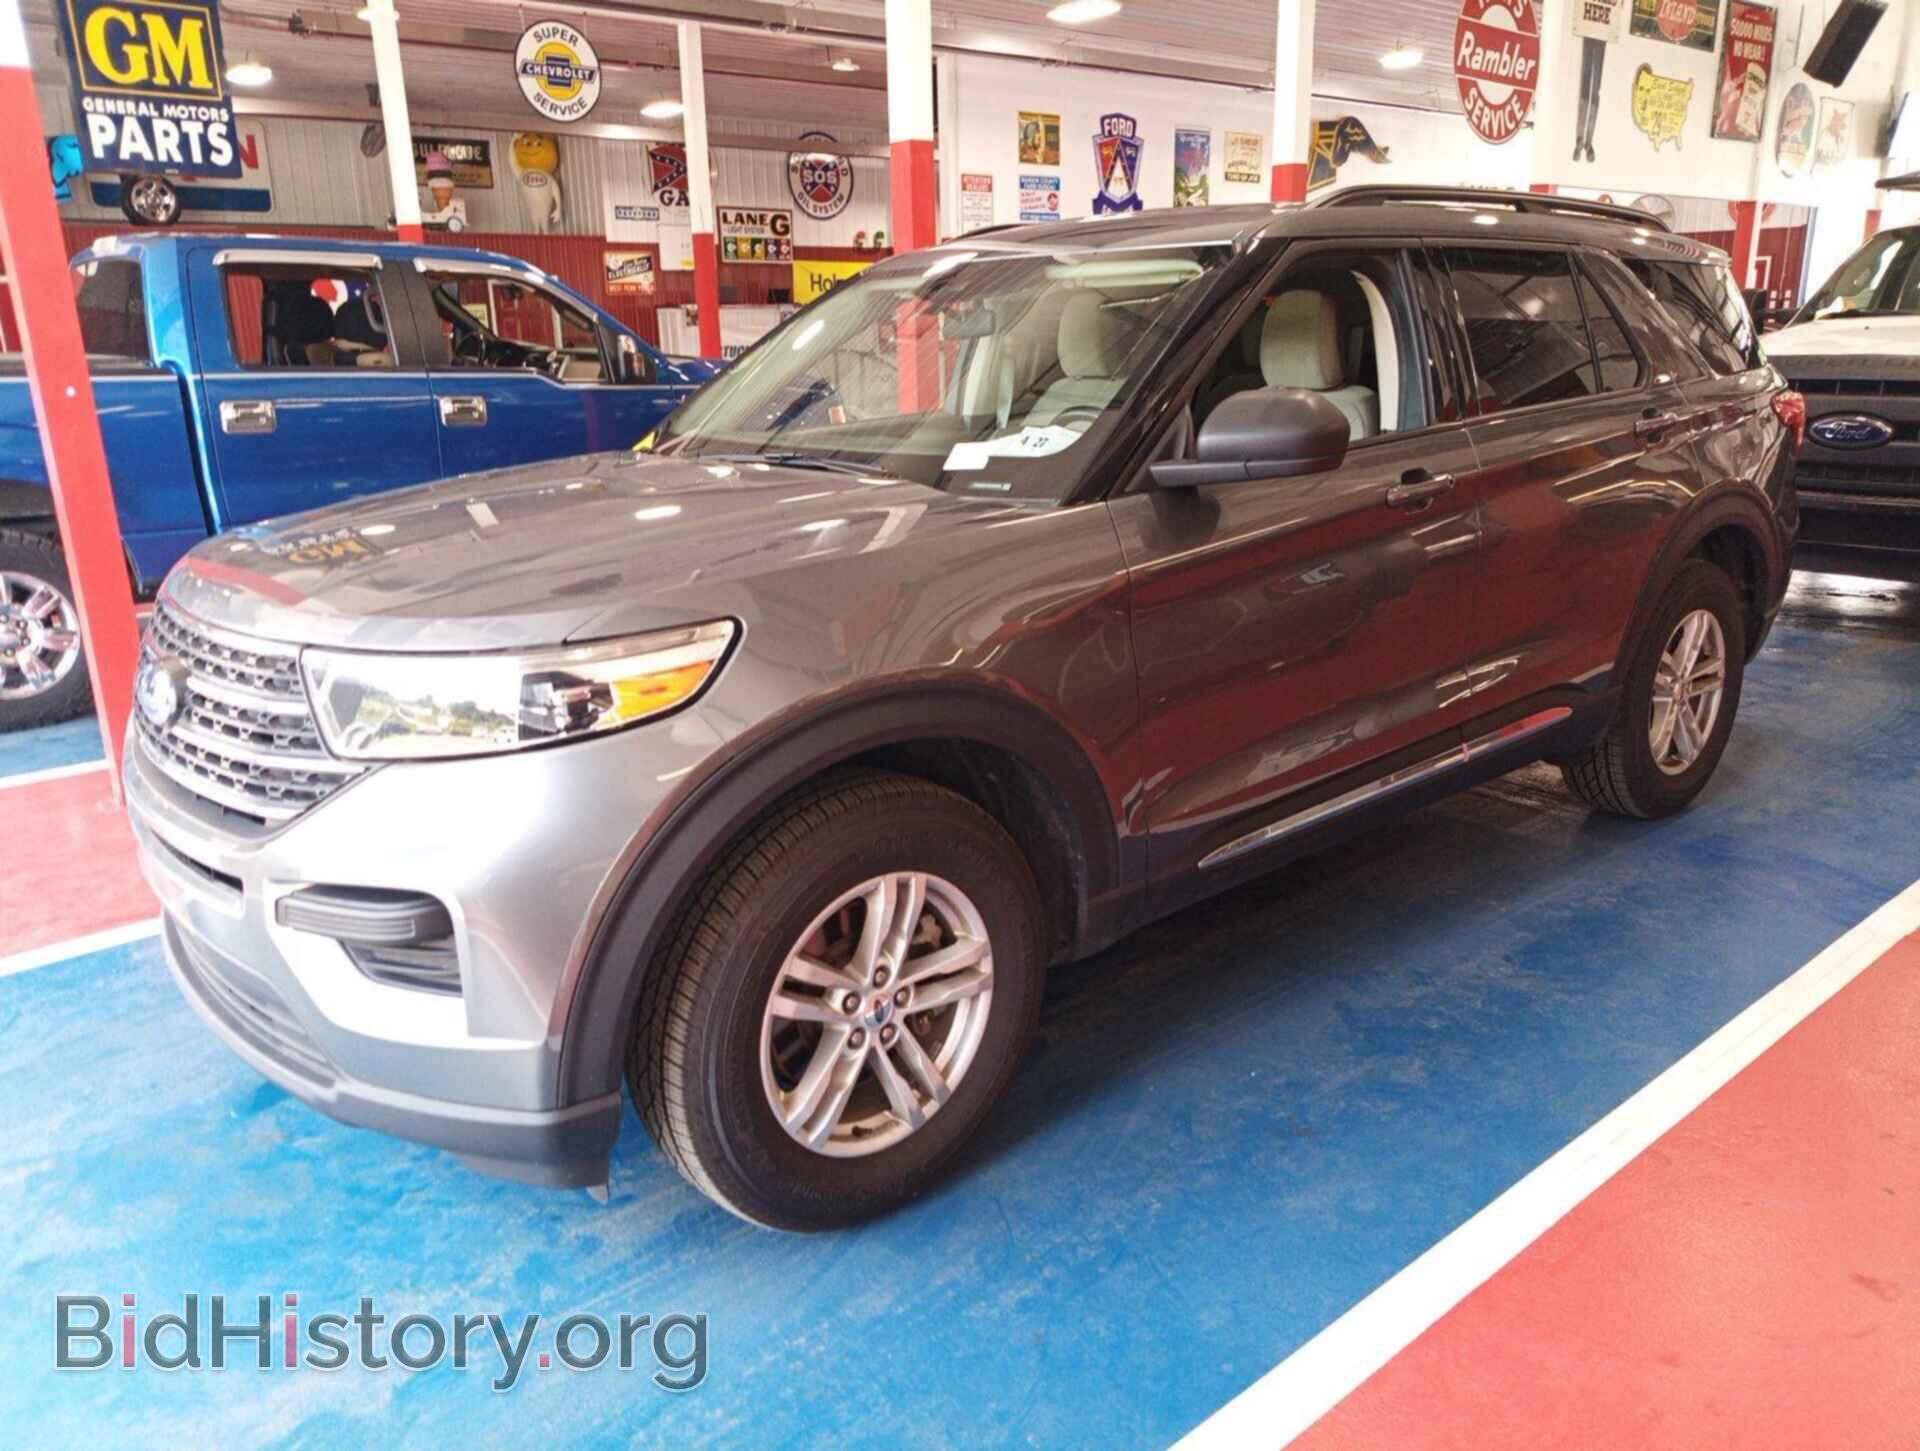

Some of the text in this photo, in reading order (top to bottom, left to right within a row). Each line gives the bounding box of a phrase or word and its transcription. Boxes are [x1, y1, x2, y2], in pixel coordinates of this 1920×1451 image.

[1583, 2, 1612, 24] HERE
[84, 6, 214, 89] GM
[533, 26, 579, 47] SUPER
[1456, 30, 1537, 81] Rambler
[525, 63, 591, 79] CHEVROLET
[82, 96, 230, 122] GENERAL MOTORS
[533, 92, 588, 116] SERVICE
[1464, 87, 1524, 138] SERVICE
[1103, 116, 1134, 139] FORD
[86, 113, 234, 167] PARTS
[803, 169, 837, 182] SOS
[659, 189, 690, 207] GA
[797, 191, 845, 214] OIL SYSTEM
[722, 212, 790, 236] LANE G
[810, 272, 846, 292] Hol
[1817, 421, 1872, 439] Ford
